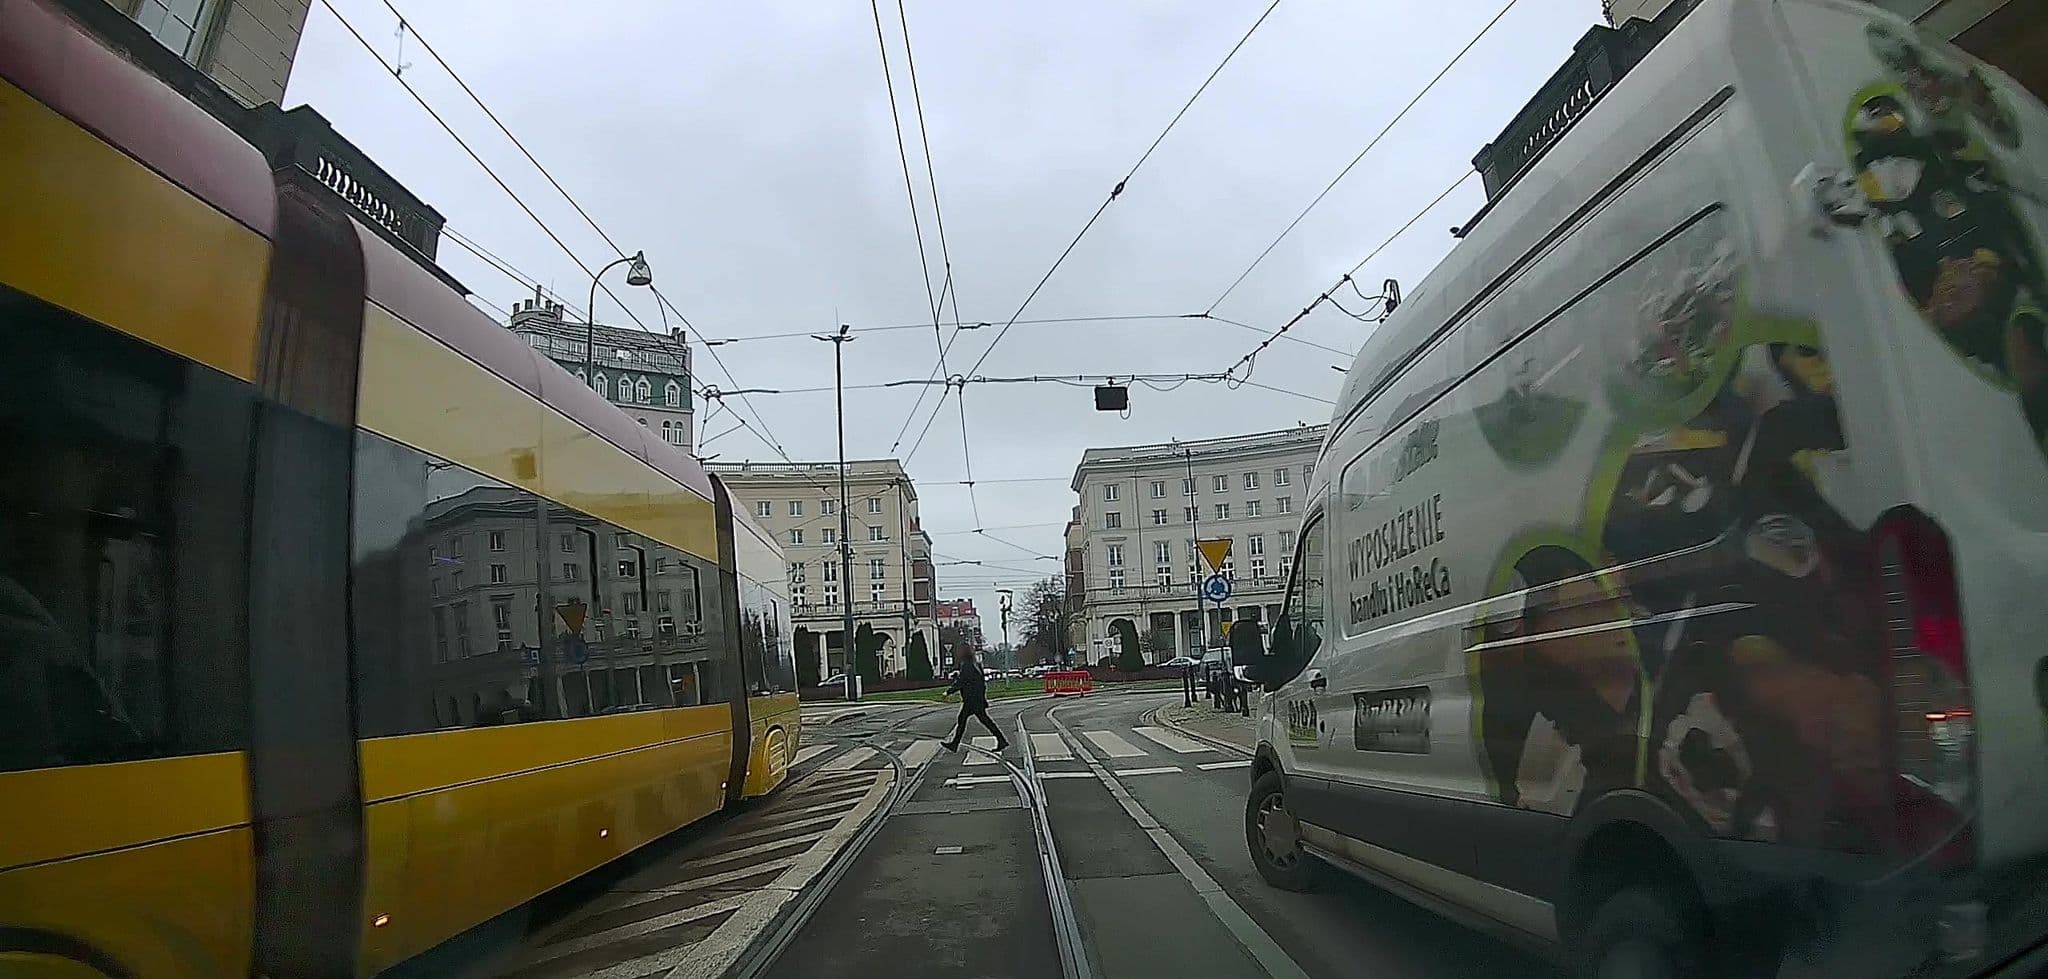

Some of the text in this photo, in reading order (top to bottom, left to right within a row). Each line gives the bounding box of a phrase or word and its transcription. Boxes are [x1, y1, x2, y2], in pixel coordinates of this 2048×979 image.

[1347, 493, 1445, 581] WYPOSAŻENIE
[1350, 580, 1388, 624] handlu
[1395, 557, 1451, 611] HoReCa
